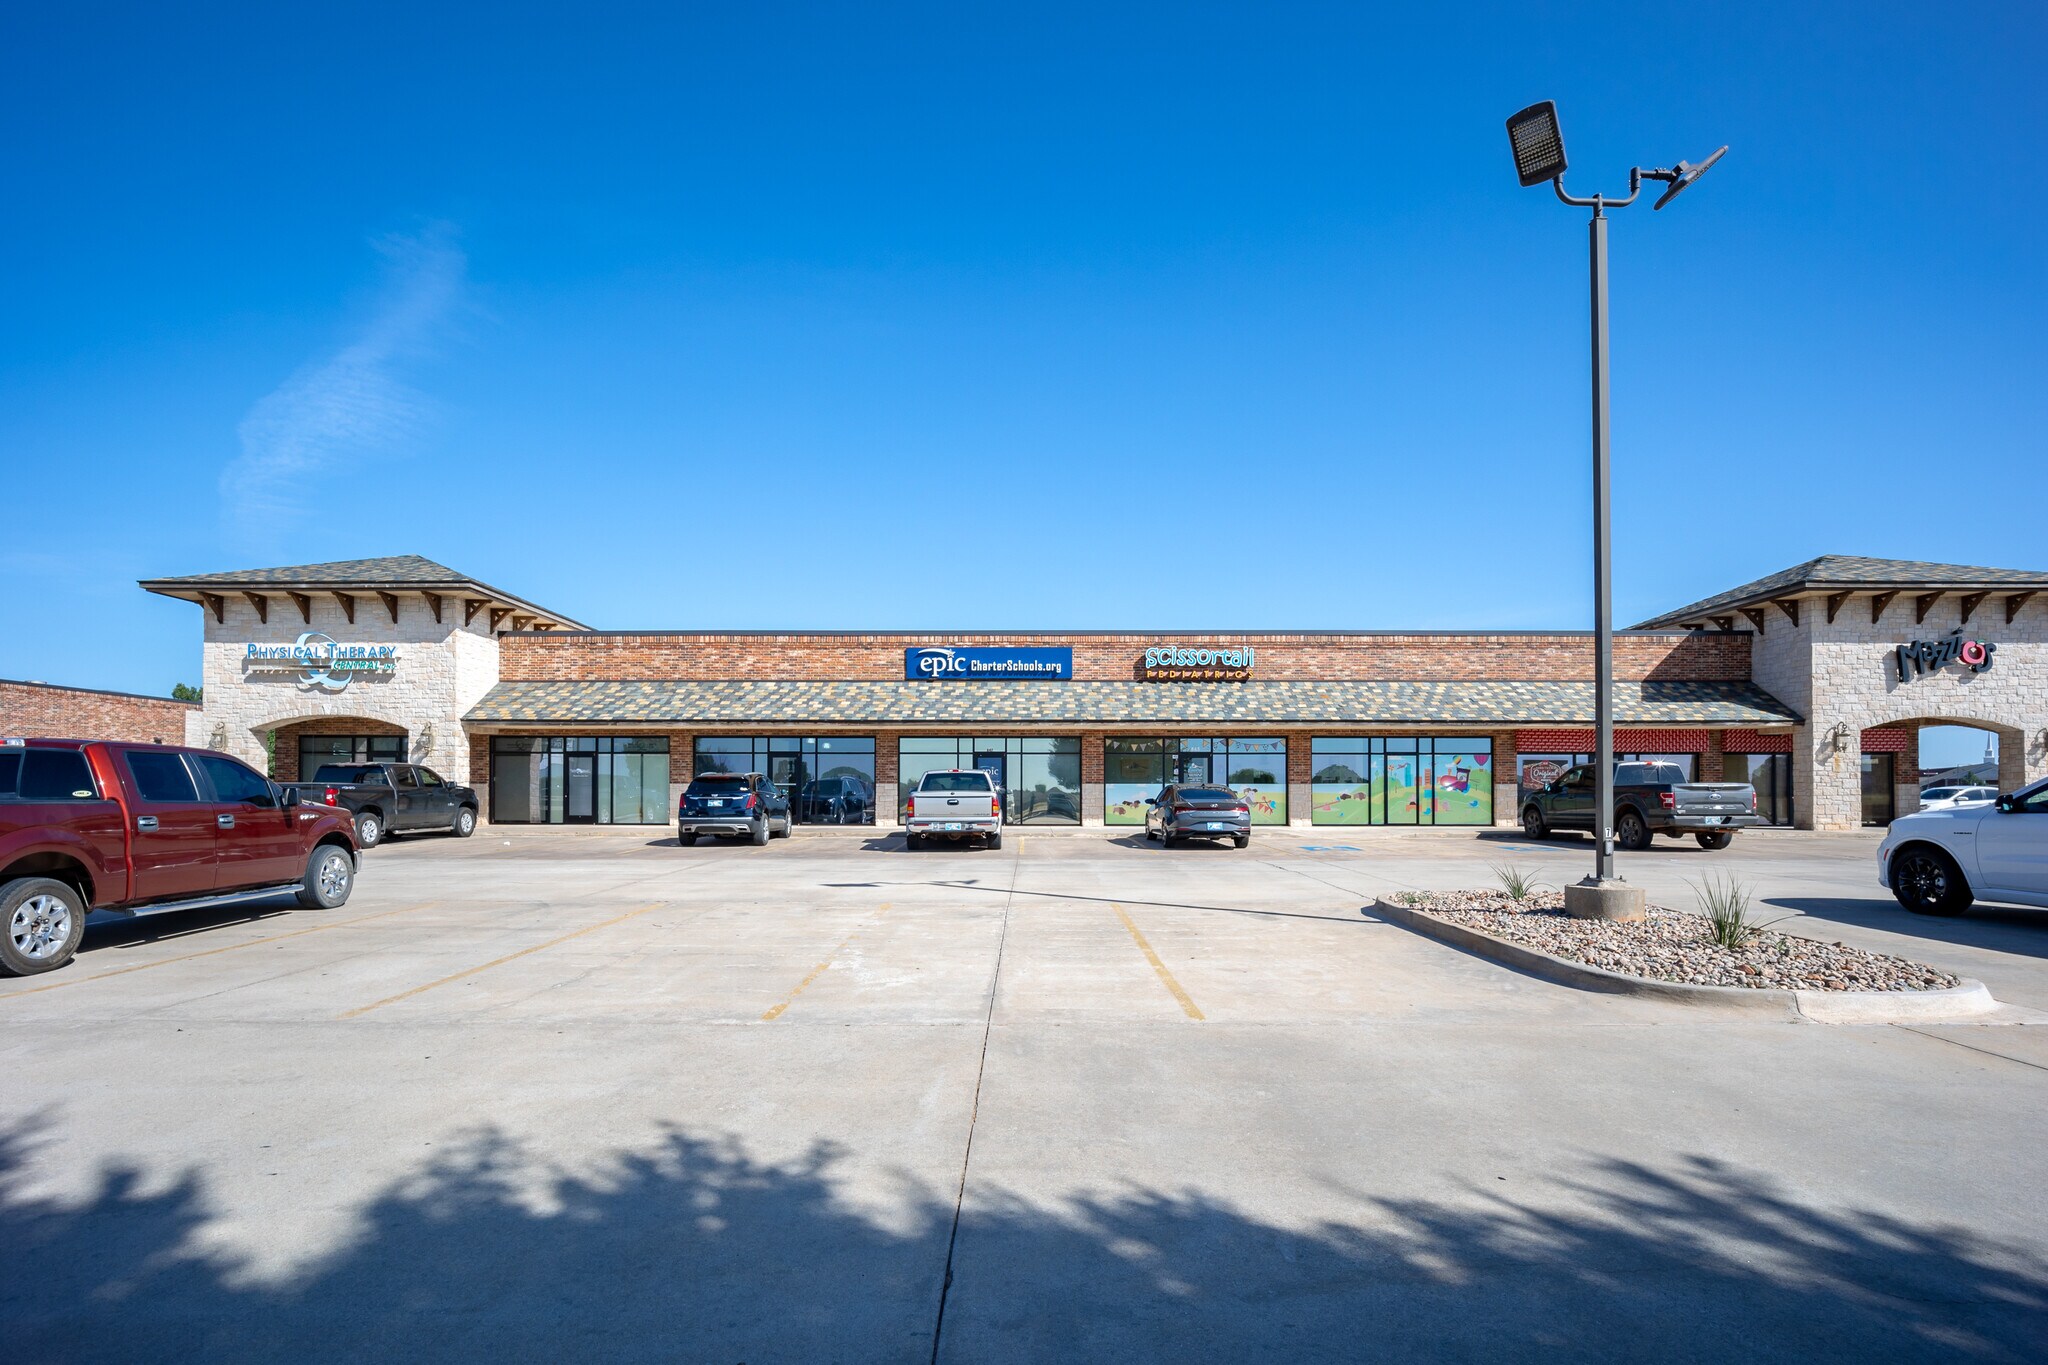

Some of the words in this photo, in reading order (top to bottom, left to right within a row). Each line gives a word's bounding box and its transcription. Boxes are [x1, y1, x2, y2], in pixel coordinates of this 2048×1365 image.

[333, 660, 380, 670] CENTRAL
[920, 651, 966, 677] epic
[970, 660, 1062, 673] CharterSchools.org
[1147, 670, 1254, 679] PEDIATRICS
